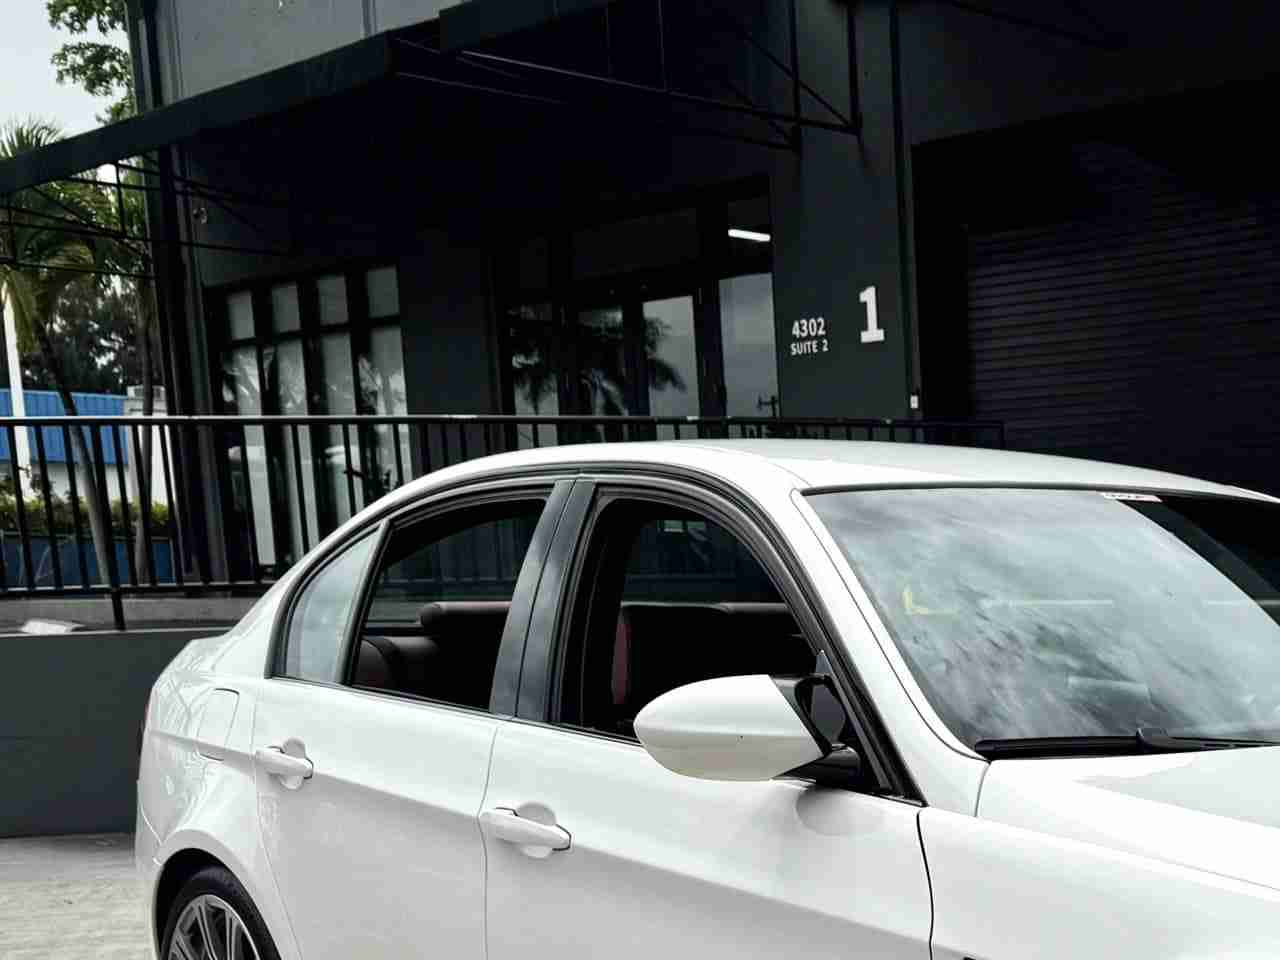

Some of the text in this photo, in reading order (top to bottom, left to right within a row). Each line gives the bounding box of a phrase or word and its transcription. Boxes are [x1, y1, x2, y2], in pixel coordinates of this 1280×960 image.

[859, 285, 885, 343] 1
[791, 317, 826, 338] 4302
[790, 339, 829, 356] SUITE 2
